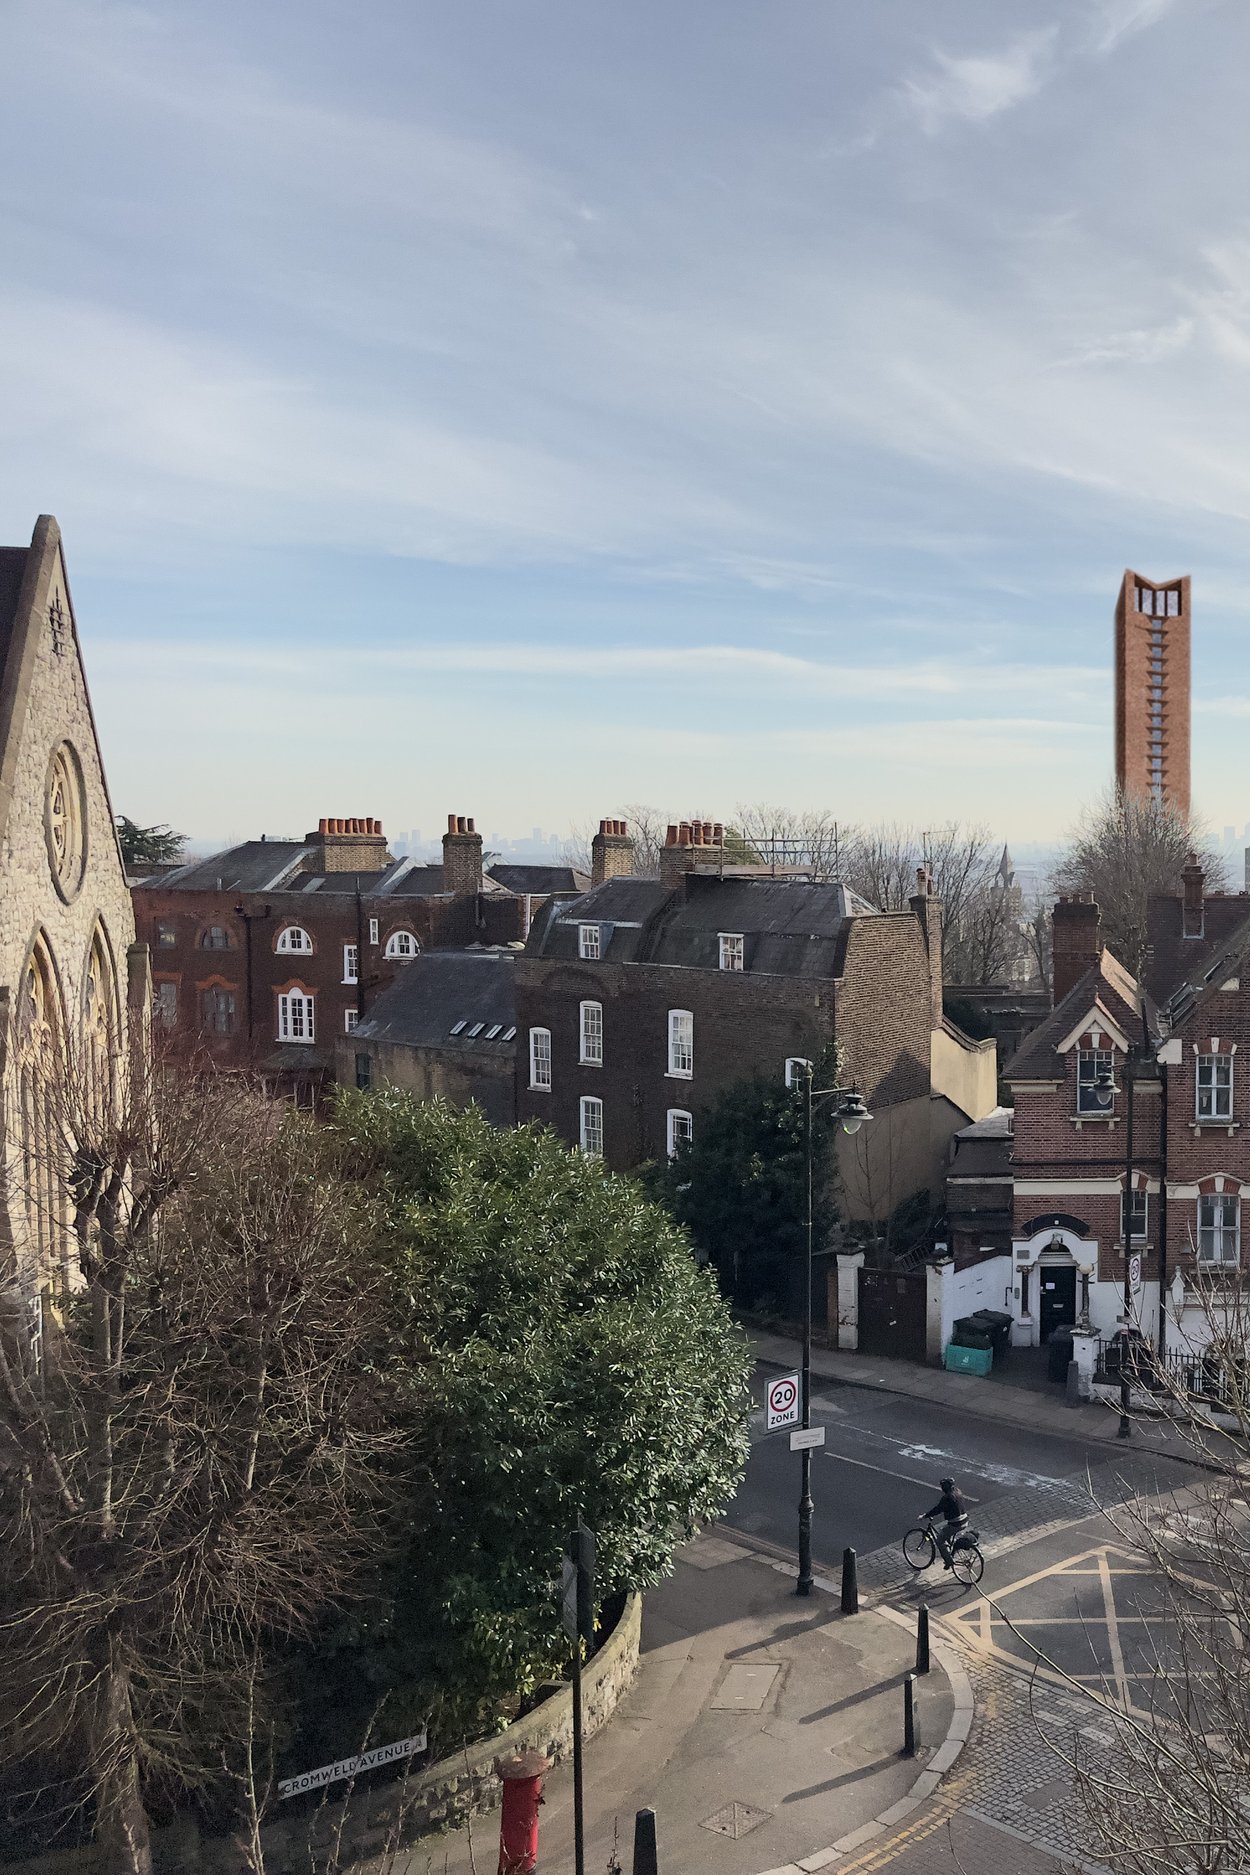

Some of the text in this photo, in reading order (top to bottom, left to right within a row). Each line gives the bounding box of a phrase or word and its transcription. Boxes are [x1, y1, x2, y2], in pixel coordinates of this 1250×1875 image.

[775, 1389, 793, 1404] 20
[771, 1411, 794, 1424] ZONE
[284, 1742, 410, 1793] CROMWELL AVENUE
